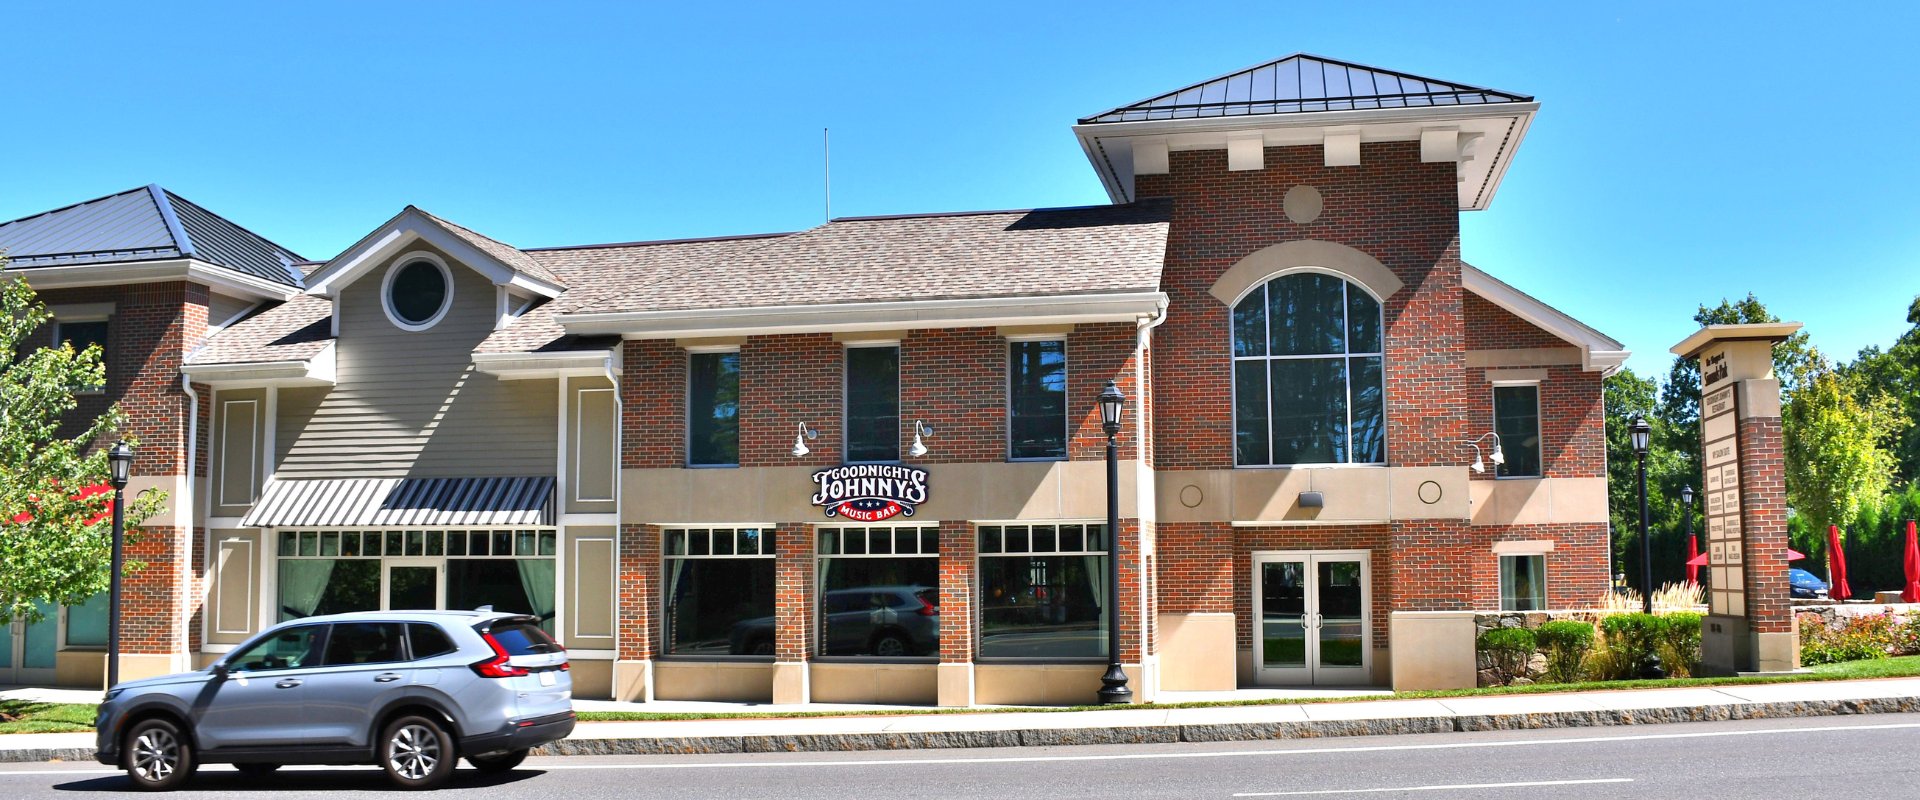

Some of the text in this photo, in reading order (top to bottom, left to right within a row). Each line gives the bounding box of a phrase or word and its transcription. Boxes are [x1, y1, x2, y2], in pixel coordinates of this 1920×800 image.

[831, 465, 911, 480] GOODNIGHT
[812, 469, 926, 504] JOHNNY'S
[840, 505, 897, 520] MUSIC BAR
